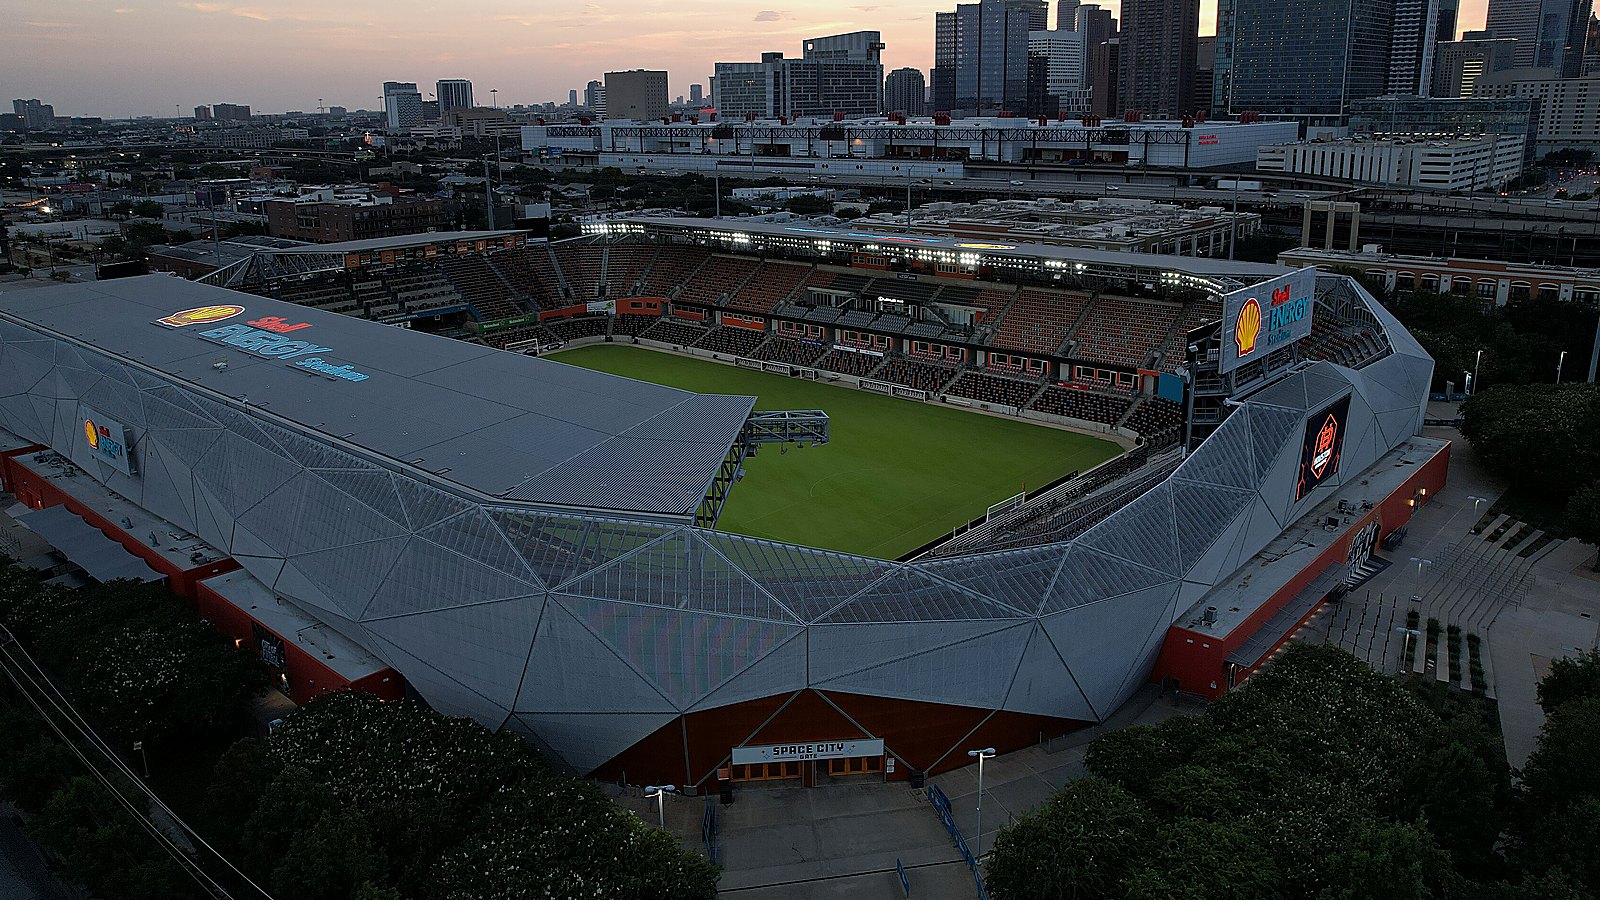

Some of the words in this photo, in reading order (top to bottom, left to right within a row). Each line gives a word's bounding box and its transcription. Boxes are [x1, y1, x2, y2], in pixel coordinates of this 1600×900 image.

[1271, 285, 1290, 306] Shell
[1270, 297, 1309, 331] ENERGY
[198, 323, 333, 360] ENERGY
[773, 745, 813, 755] SPACE
[817, 743, 843, 753] CITY
